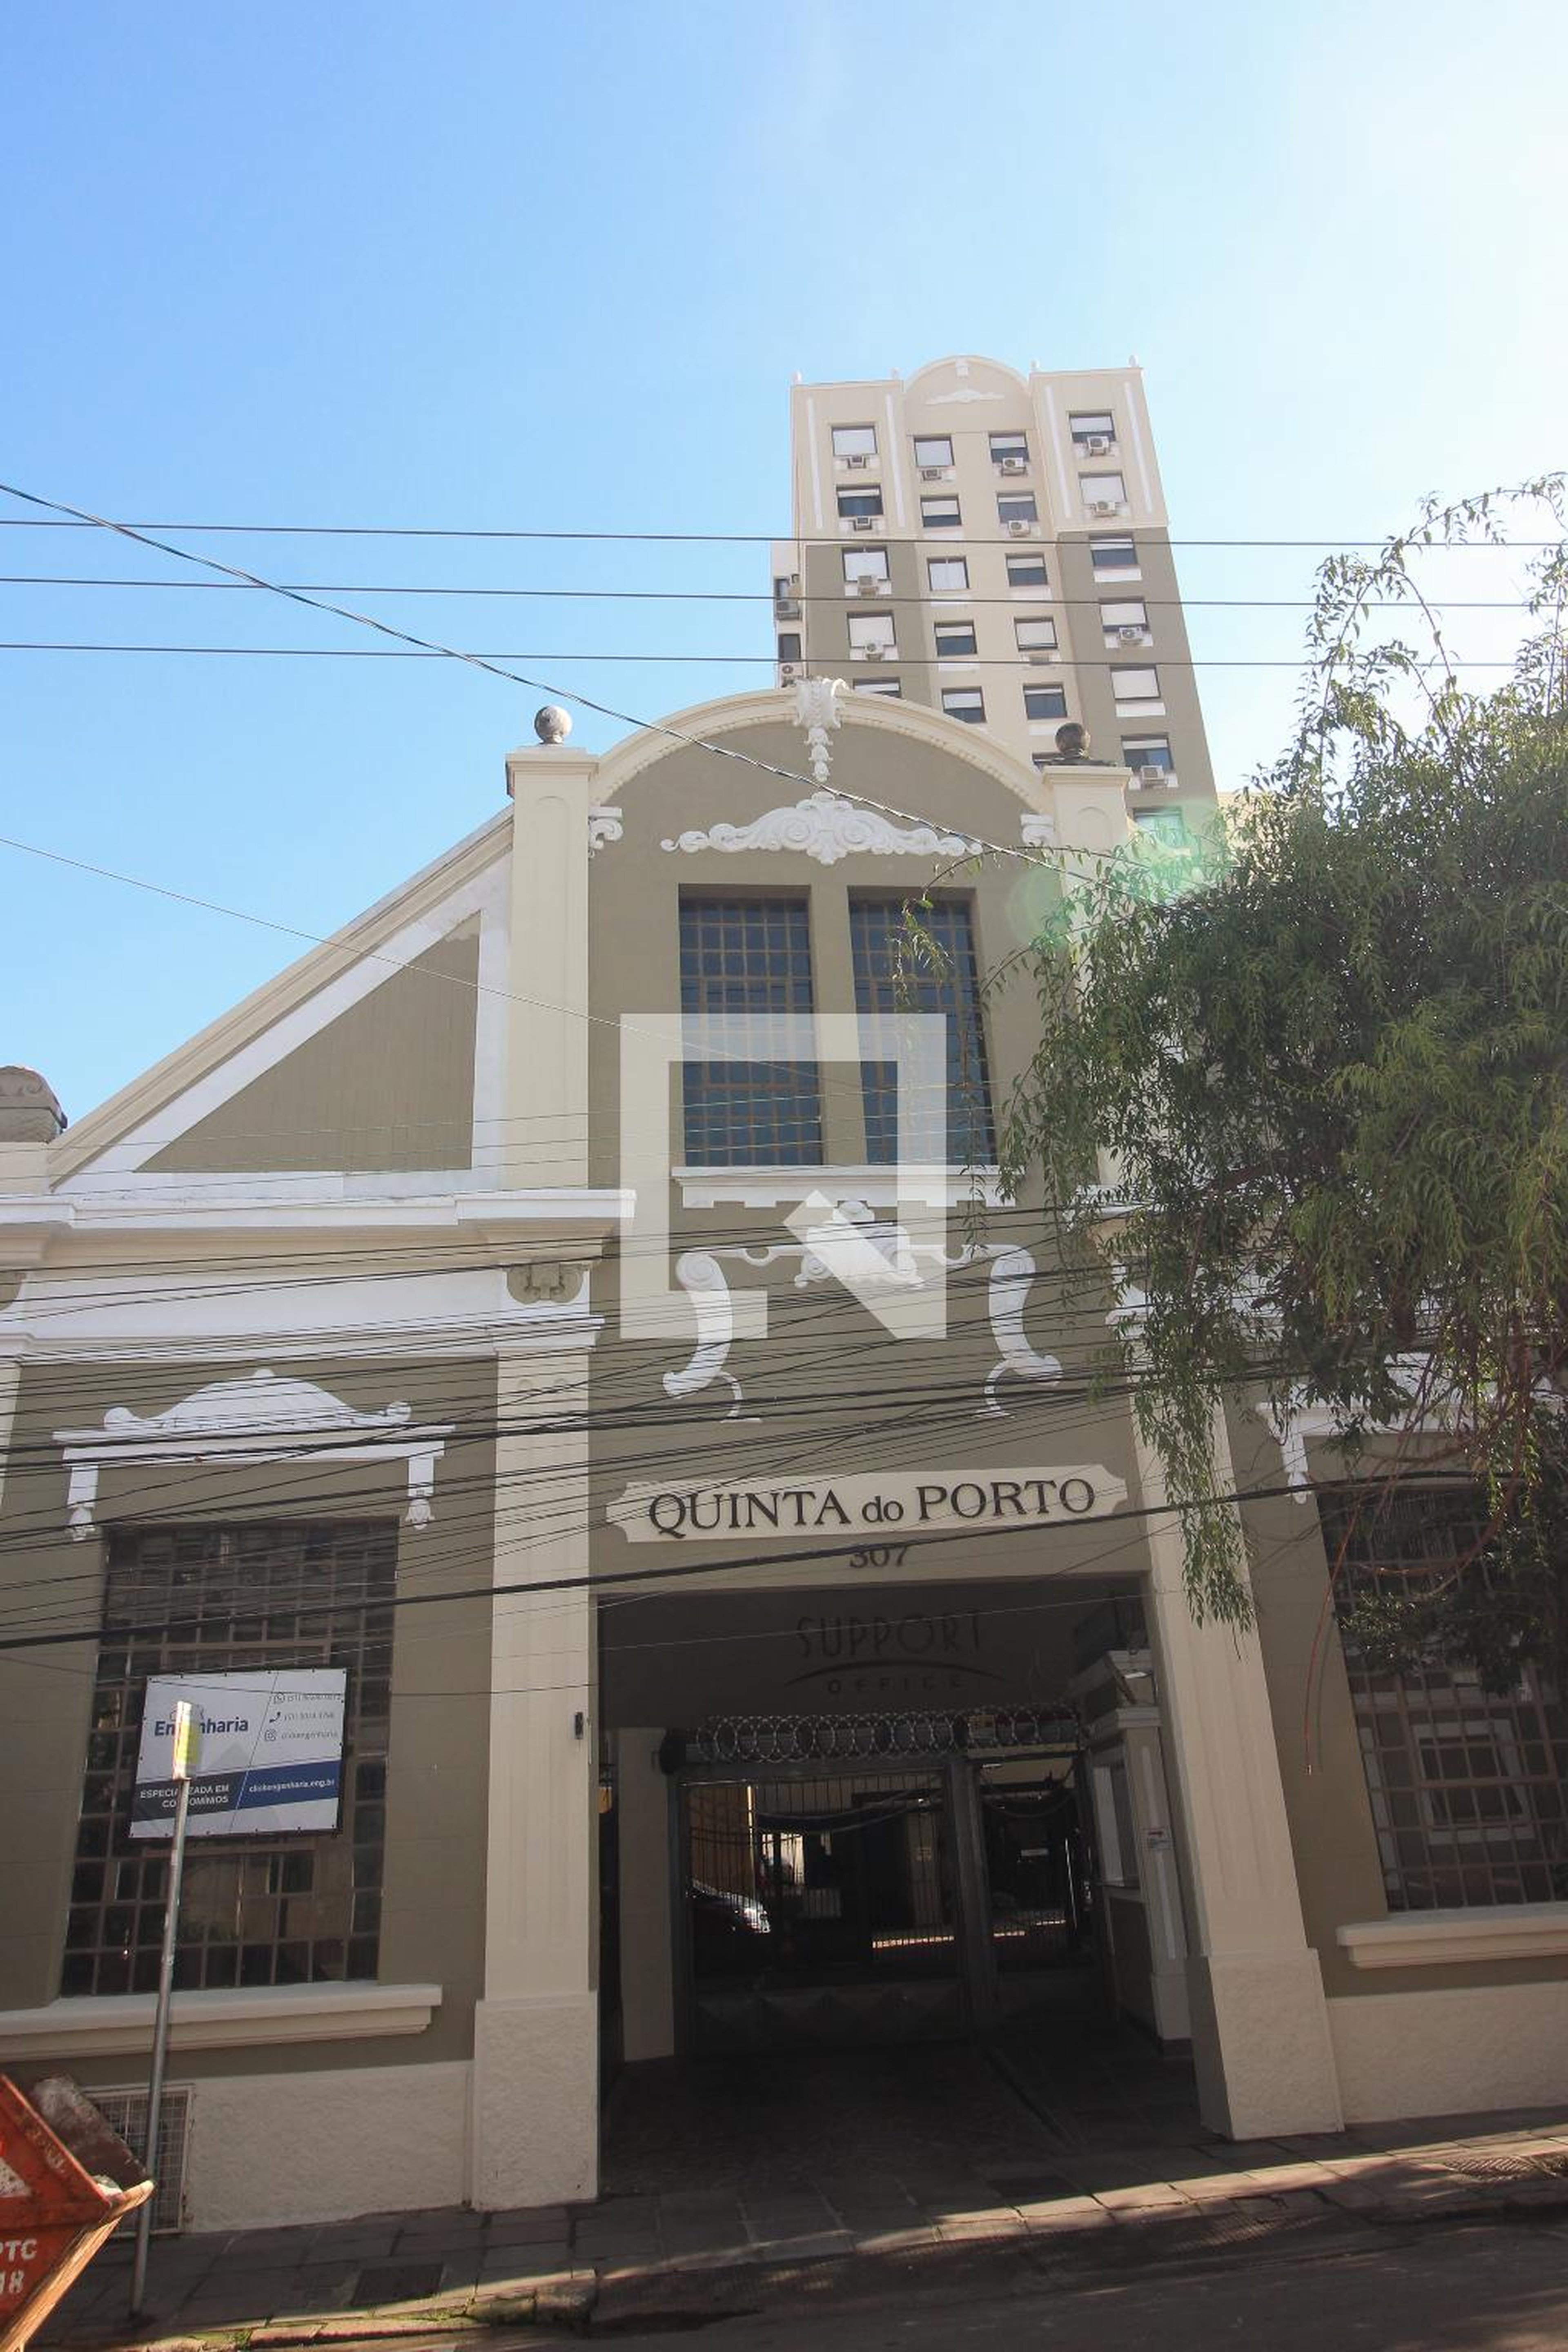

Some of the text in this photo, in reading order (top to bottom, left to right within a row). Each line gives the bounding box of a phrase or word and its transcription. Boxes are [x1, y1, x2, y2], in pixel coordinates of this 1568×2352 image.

[650, 1478, 1096, 1539] QUINTA do PORTO
[797, 1607, 981, 1657] SUPPORT
[827, 1673, 969, 1695] OFFICE
[154, 1716, 249, 1736] Ennharia
